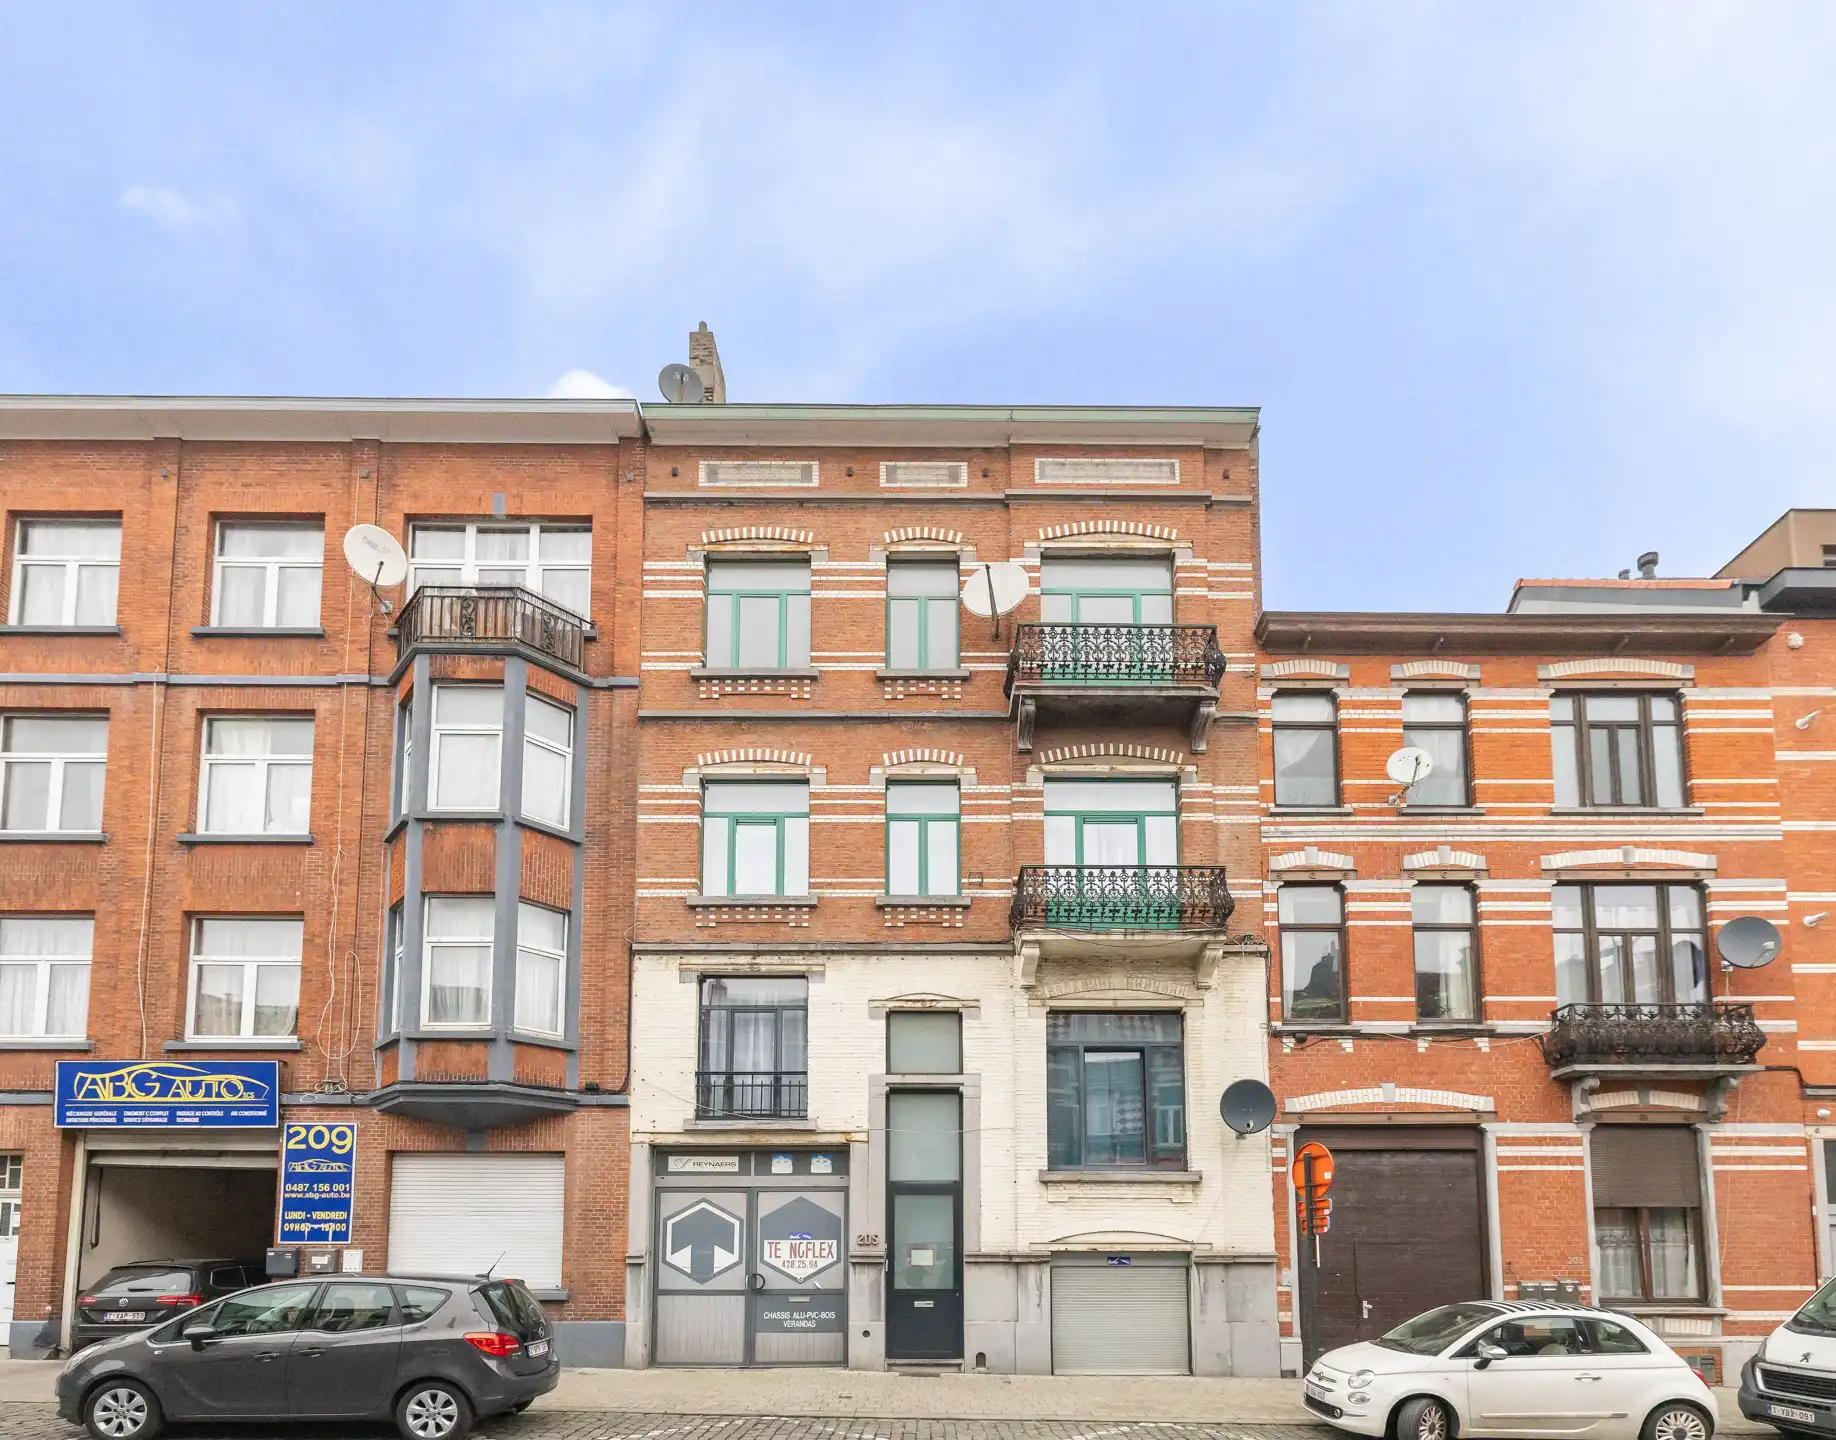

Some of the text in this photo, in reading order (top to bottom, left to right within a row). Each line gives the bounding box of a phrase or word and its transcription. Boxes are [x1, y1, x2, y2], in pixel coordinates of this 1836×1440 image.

[77, 1069, 160, 1099] ABG
[168, 1078, 243, 1099] AUTO
[287, 1125, 353, 1154] 209
[285, 1183, 350, 1192] 0487 156 001
[284, 1192, 351, 1200] www.abg-auto.be
[284, 1211, 306, 1220] LUNDI
[312, 1211, 348, 1220] VENDREDI
[1567, 1256, 1584, 1265] 203
[763, 1311, 836, 1319] CHASSIS ALU-PVC-BOIS
[783, 1320, 817, 1328] VERANDAS
